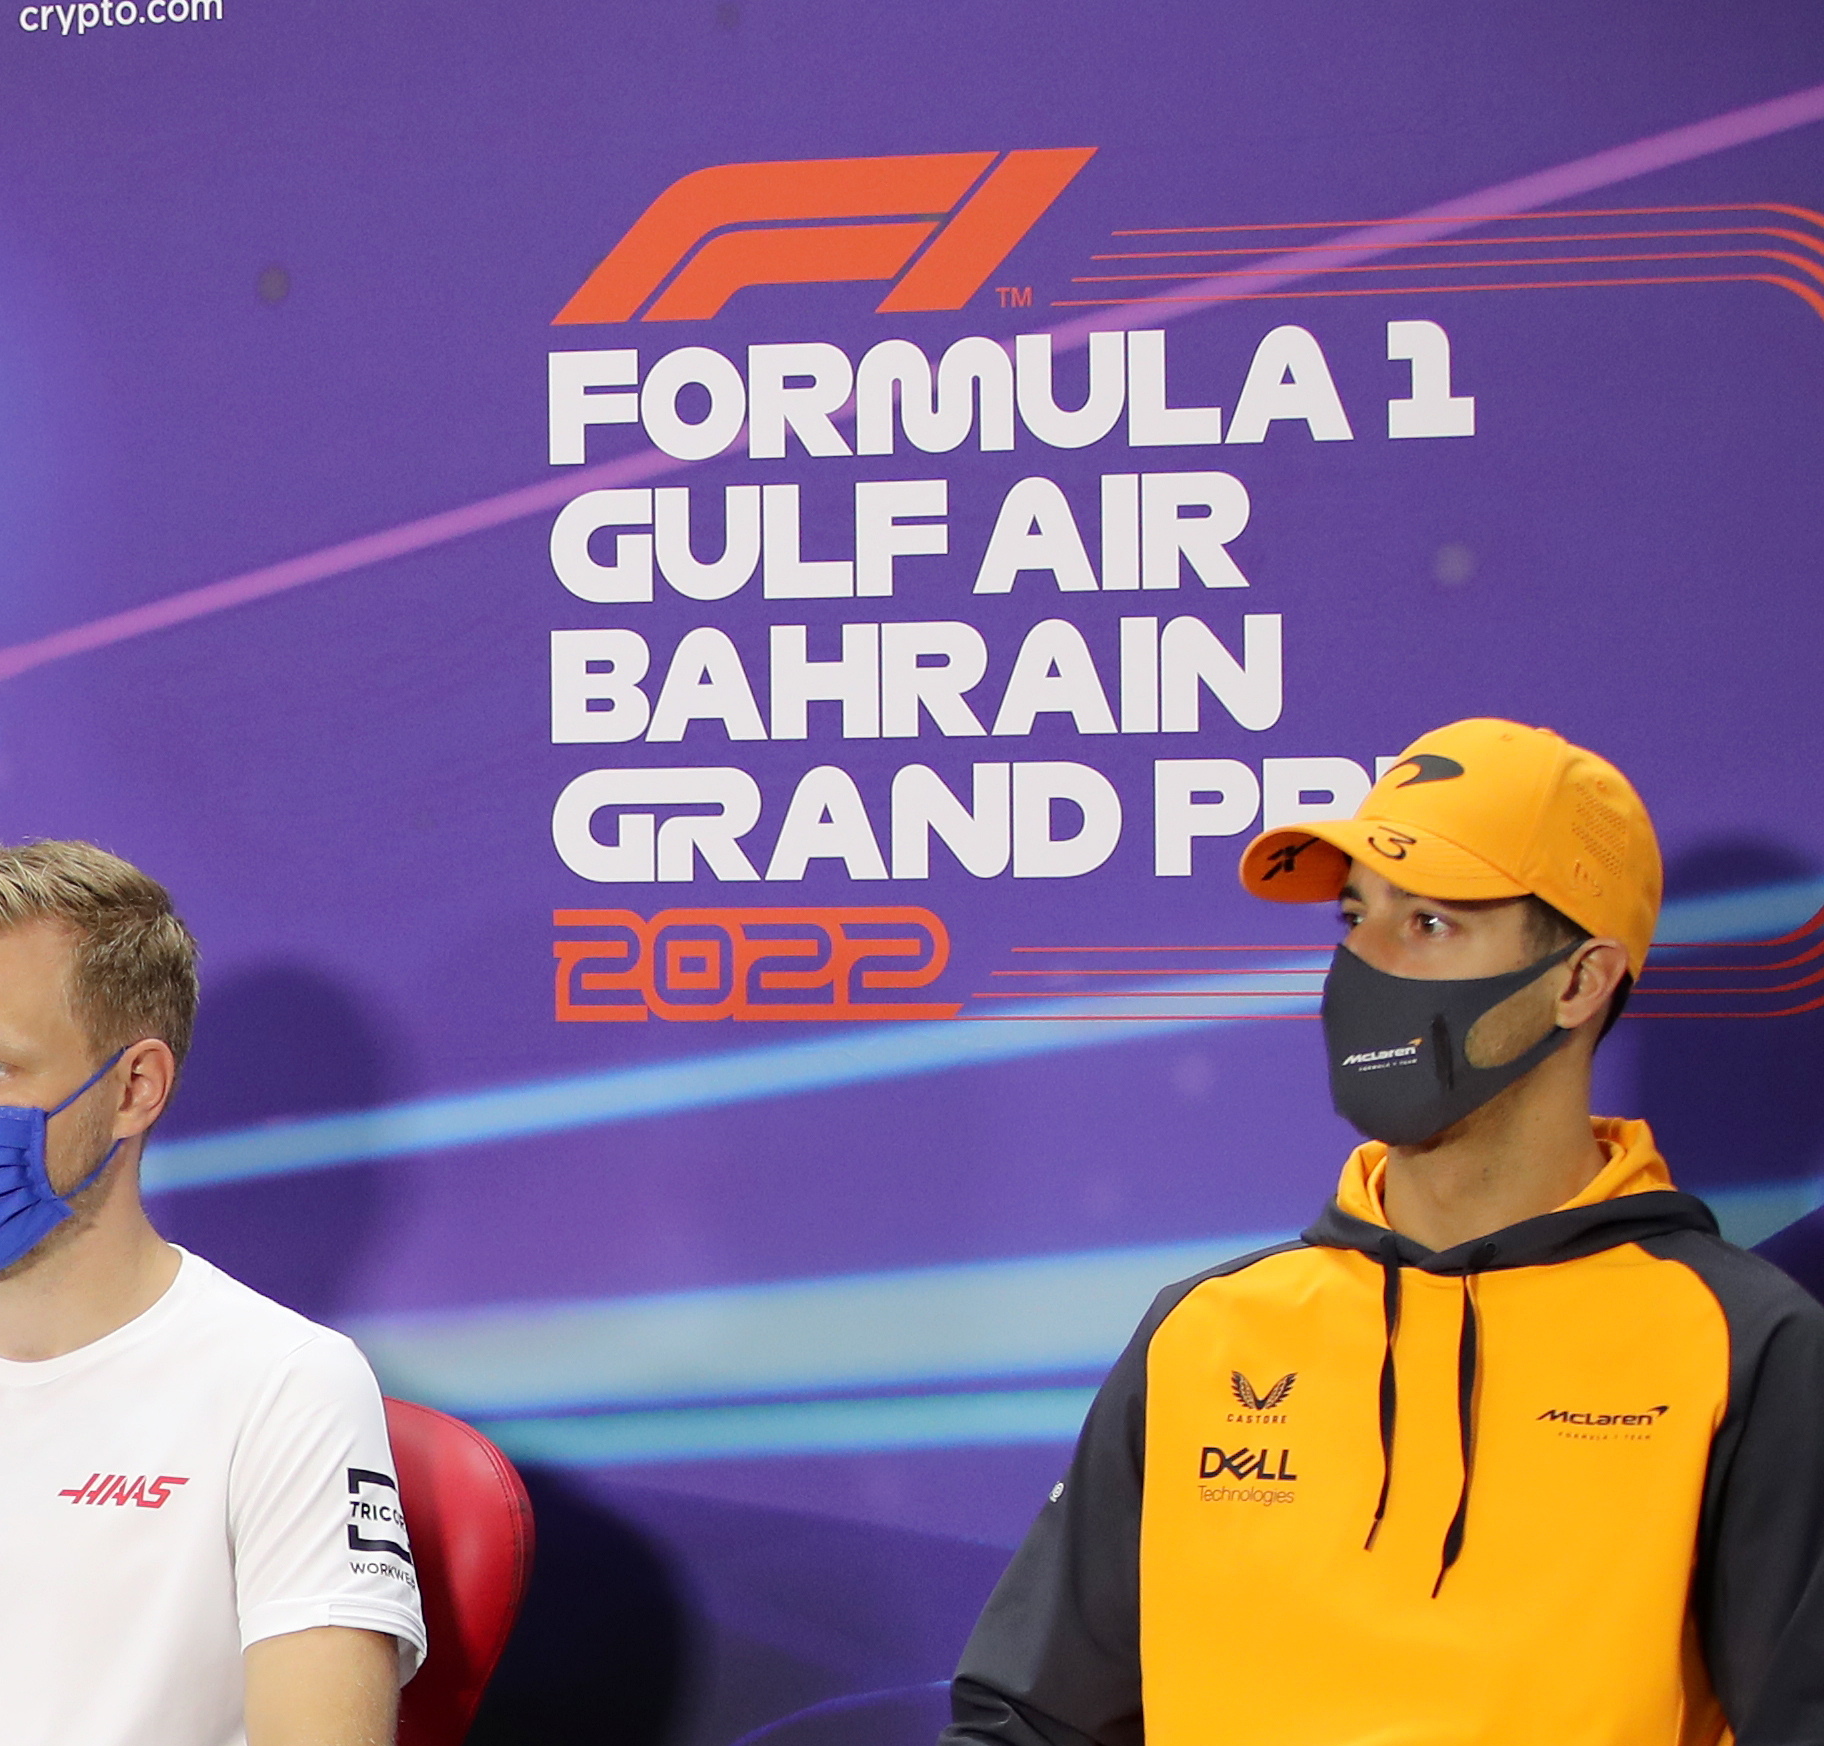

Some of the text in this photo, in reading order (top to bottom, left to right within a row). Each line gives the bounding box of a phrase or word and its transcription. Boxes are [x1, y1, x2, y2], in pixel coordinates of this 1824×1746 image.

[19, 0, 224, 35] crypto.com
[997, 287, 1032, 307] TM
[548, 319, 1475, 465] FORMULA 1
[549, 470, 1250, 603] GULF AIR
[550, 613, 1283, 743] BAHRAIN
[551, 761, 1122, 883] GRAND
[1368, 825, 1418, 860] 3
[554, 905, 956, 1022] 2022
[1342, 1046, 1416, 1066] McLaren
[1227, 1412, 1288, 1424] CASTORE
[1536, 1409, 1653, 1426] McLaren
[1199, 1446, 1298, 1482] DELL
[58, 1473, 191, 1509] HAAS
[1197, 1485, 1295, 1506] Technologies
